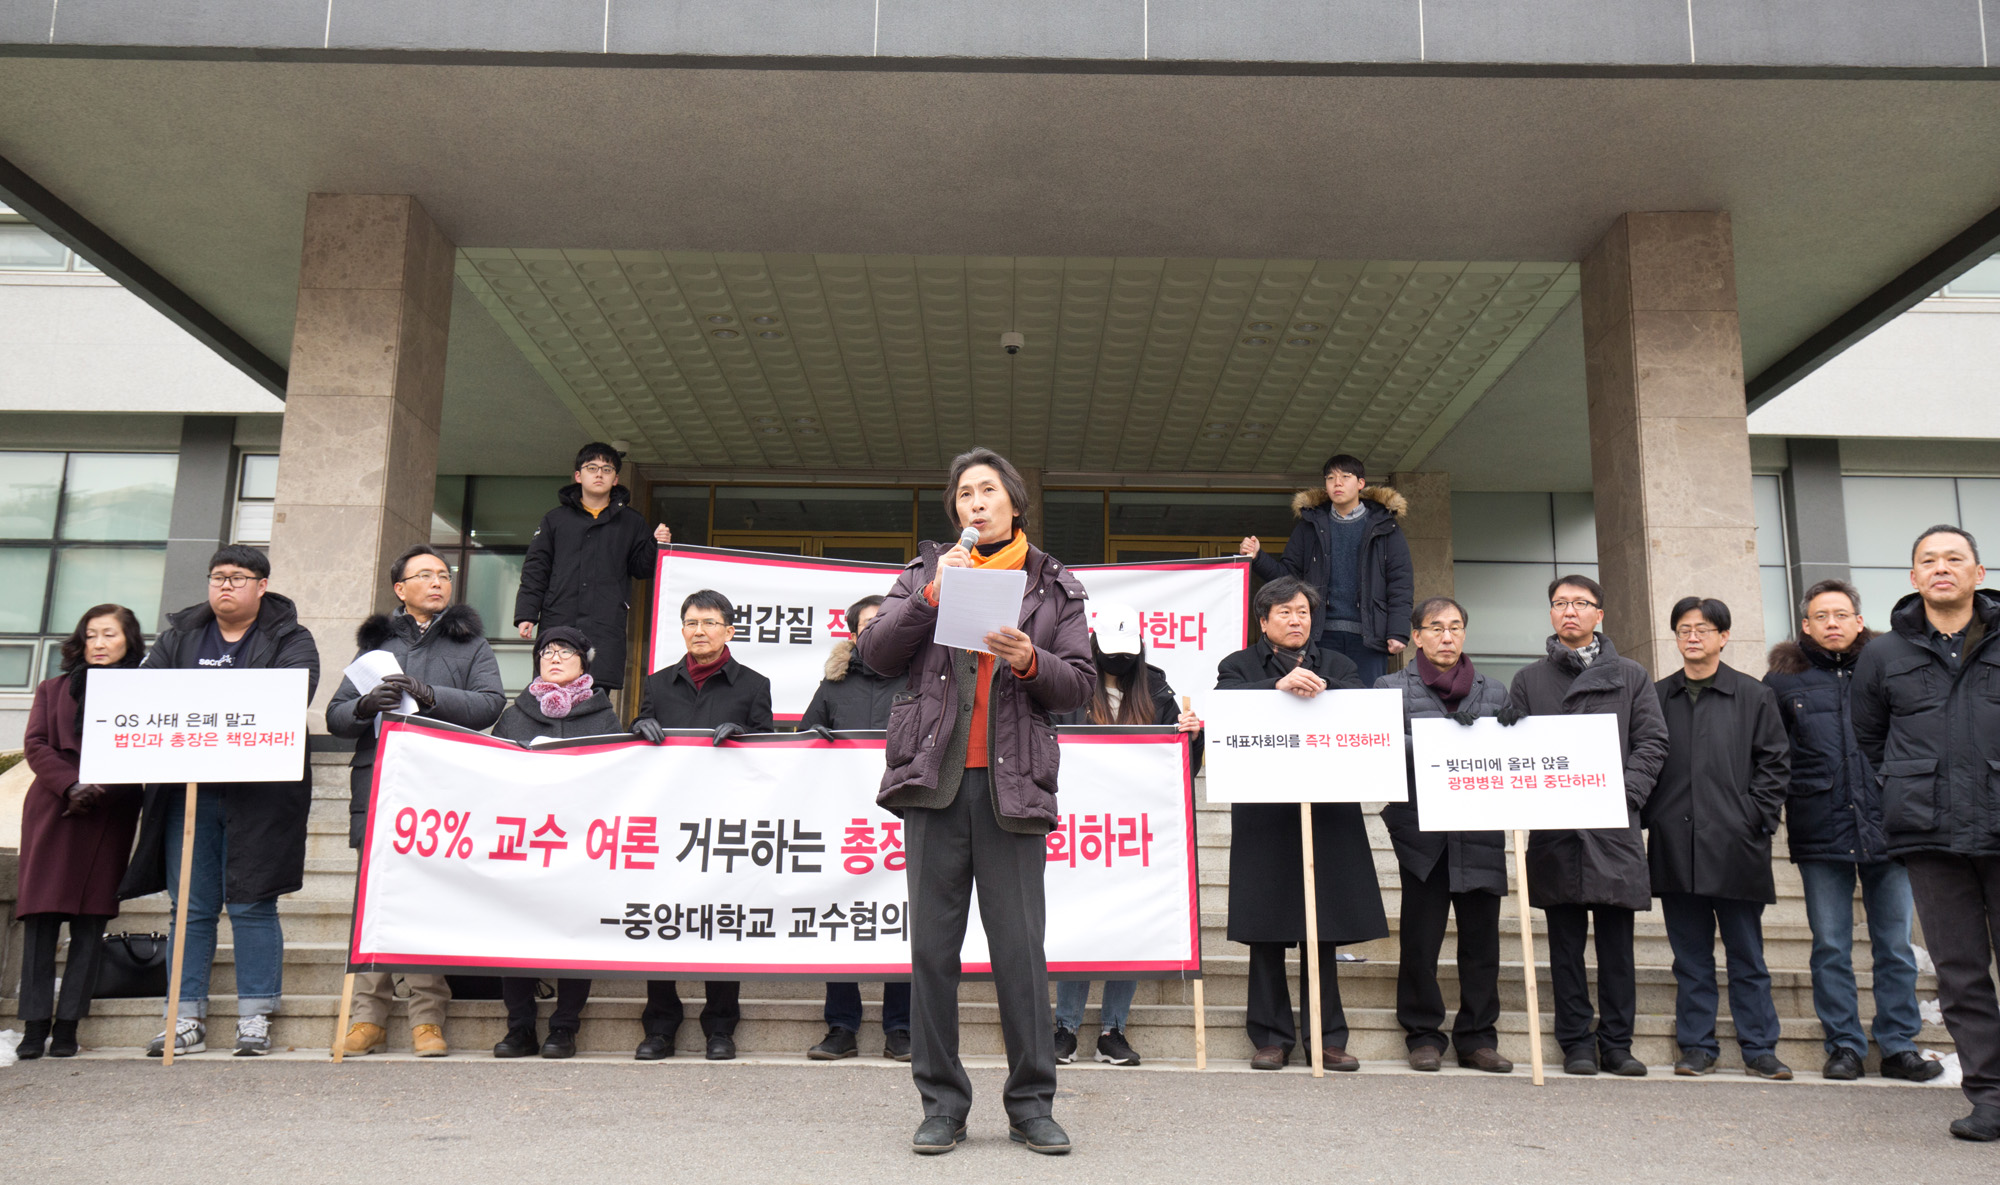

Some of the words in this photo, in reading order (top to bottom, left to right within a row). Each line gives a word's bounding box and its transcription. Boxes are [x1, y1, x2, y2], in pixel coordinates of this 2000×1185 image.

[114, 713, 140, 728] QS
[146, 712, 179, 729] 사태
[185, 713, 218, 728] 은폐
[225, 712, 257, 728] 말고
[114, 732, 164, 749] 법인과
[169, 731, 219, 748] 총장은
[226, 731, 295, 747] 책임져라!
[1226, 733, 1301, 749] 대표자회의를
[1305, 733, 1331, 748] 즉각
[1335, 732, 1391, 748] 인정하라!
[1507, 756, 1536, 772] 올라
[1541, 755, 1570, 771] 앉을
[1447, 775, 1504, 791] 광명병원
[1510, 774, 1538, 790] 건립
[1543, 773, 1607, 789] 중단하라!
[392, 806, 474, 860] 93%
[488, 813, 568, 868] 교수
[586, 815, 660, 870] 여론
[675, 817, 826, 874] 거부하는
